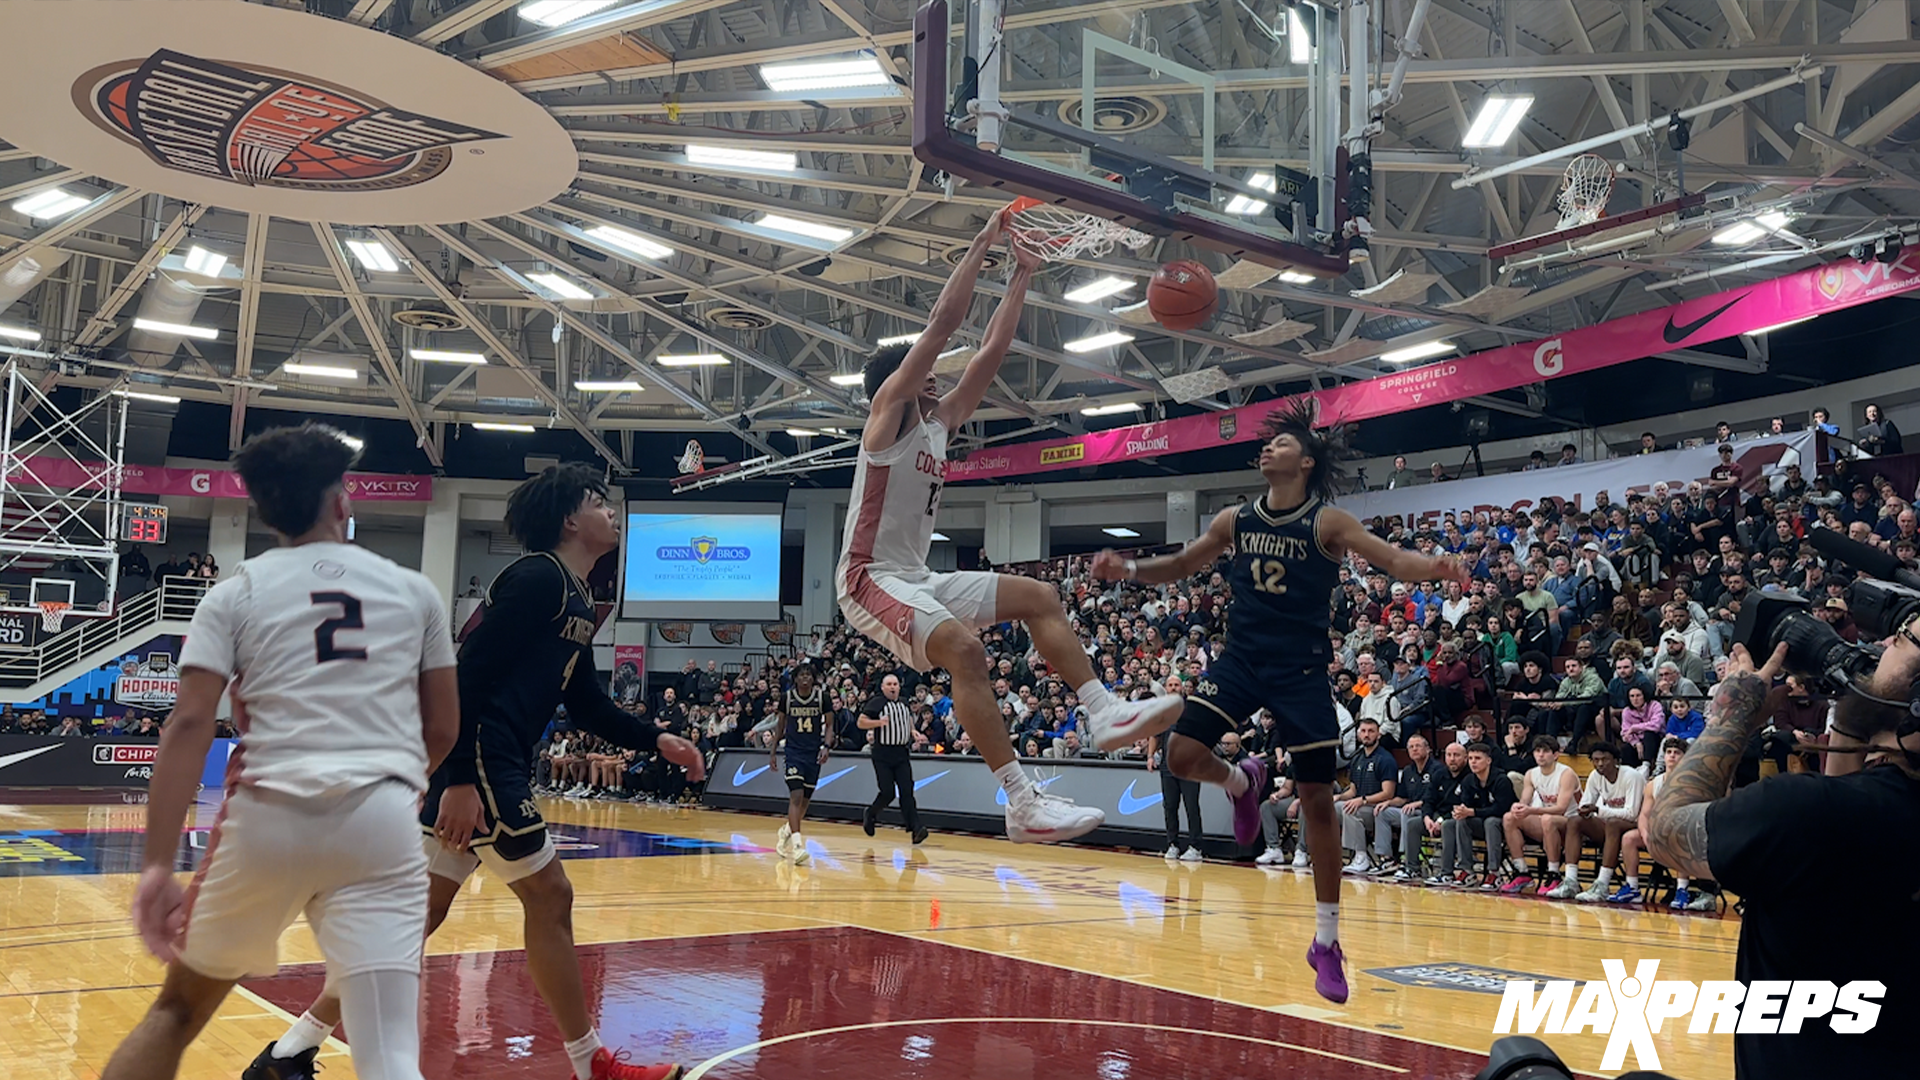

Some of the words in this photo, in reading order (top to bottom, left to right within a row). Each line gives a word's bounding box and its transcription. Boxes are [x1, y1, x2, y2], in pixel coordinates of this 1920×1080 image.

[269, 88, 364, 122] OF
[138, 59, 273, 175] BASKETBALL
[319, 110, 484, 157] FAME
[1379, 365, 1457, 391] SPRINGFIELD
[1398, 381, 1437, 394] COLLEGE
[1043, 446, 1082, 462] PANINI
[1126, 436, 1169, 456] SPALDING
[950, 459, 979, 475] Morgan
[980, 456, 1012, 470] Stanley
[360, 481, 420, 491] VKTRY
[131, 519, 160, 541] 33
[661, 548, 690, 558] DINN
[716, 548, 748, 558] BROS.
[1241, 532, 1307, 560] KNIGHTS
[1251, 558, 1287, 594] 12
[309, 590, 368, 665] 2
[561, 649, 580, 691] 4
[790, 707, 819, 717] KNIGHTS
[797, 717, 813, 732] 14
